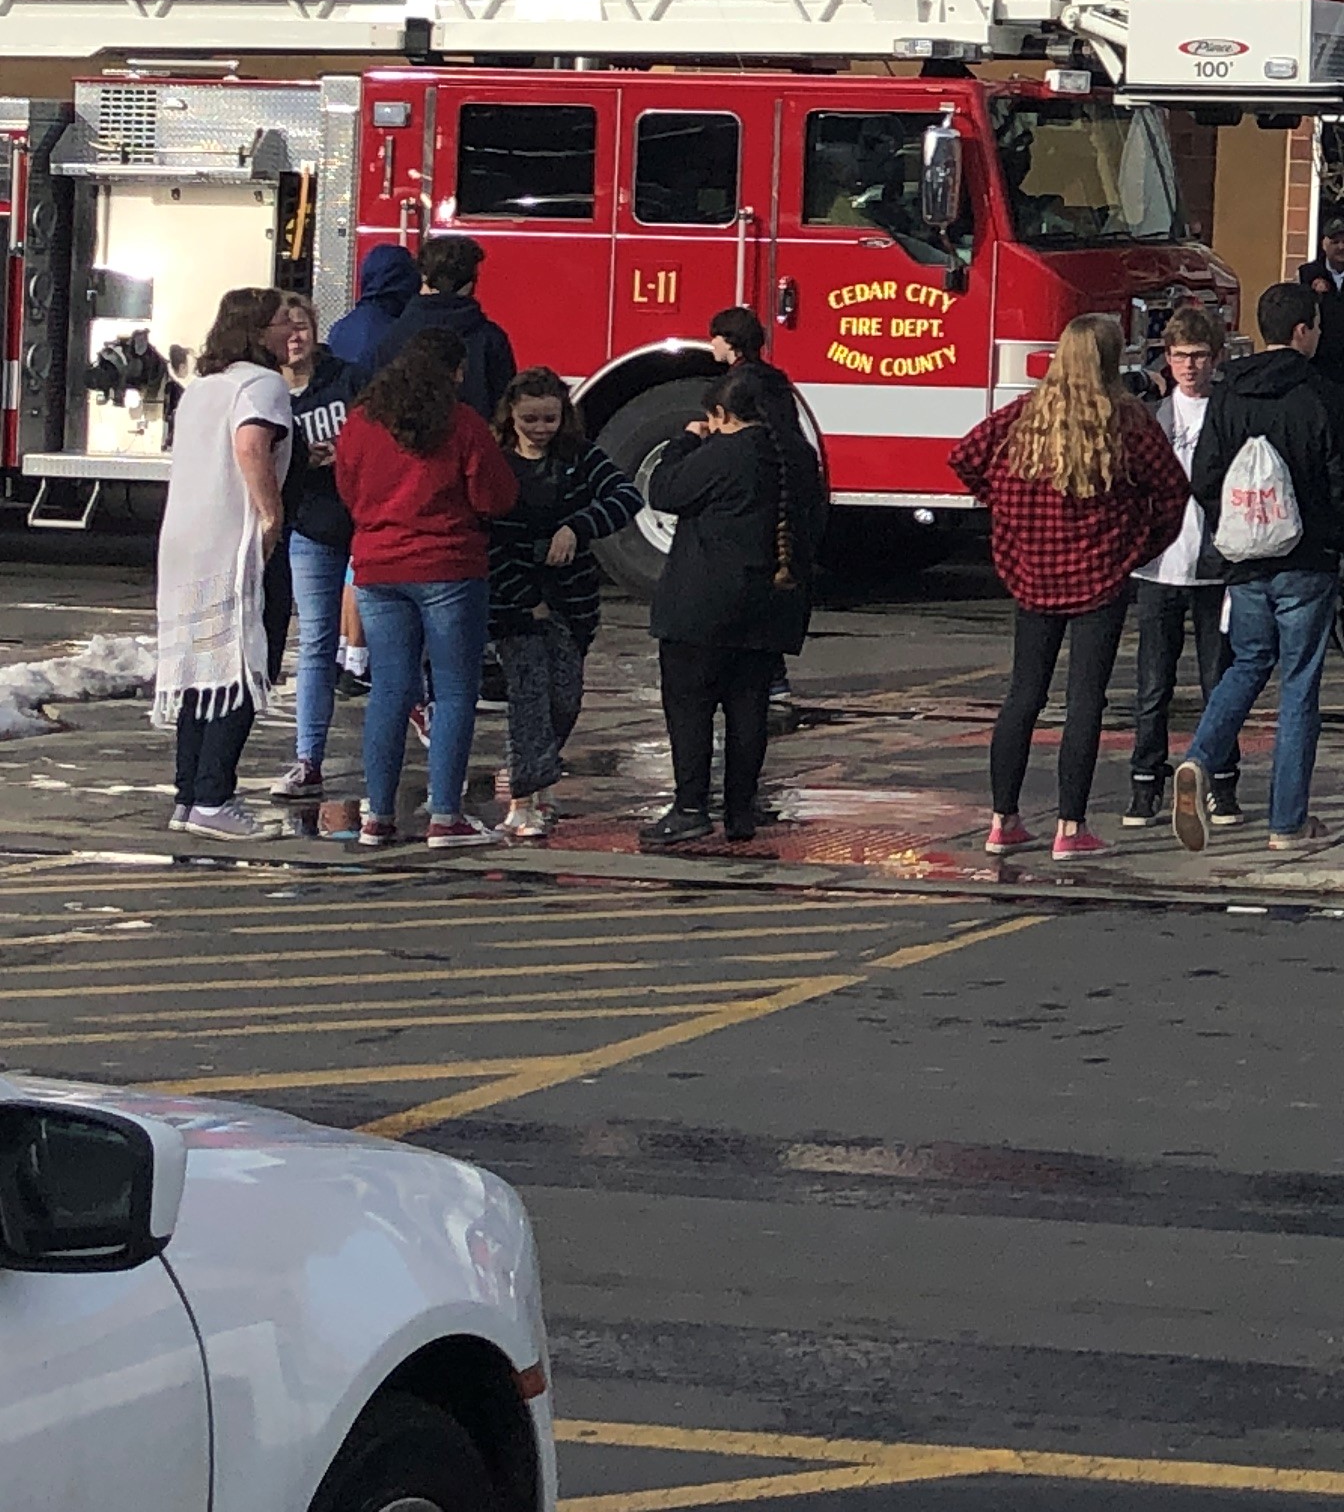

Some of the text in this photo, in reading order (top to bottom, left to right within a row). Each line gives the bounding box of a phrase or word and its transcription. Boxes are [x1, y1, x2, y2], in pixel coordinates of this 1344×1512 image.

[633, 268, 677, 304] L-11
[827, 280, 957, 314] CEDAR CITY
[840, 317, 945, 338] FIRE DEPT.
[827, 341, 956, 377] IRON COUNTY
[293, 400, 348, 445] TAR
